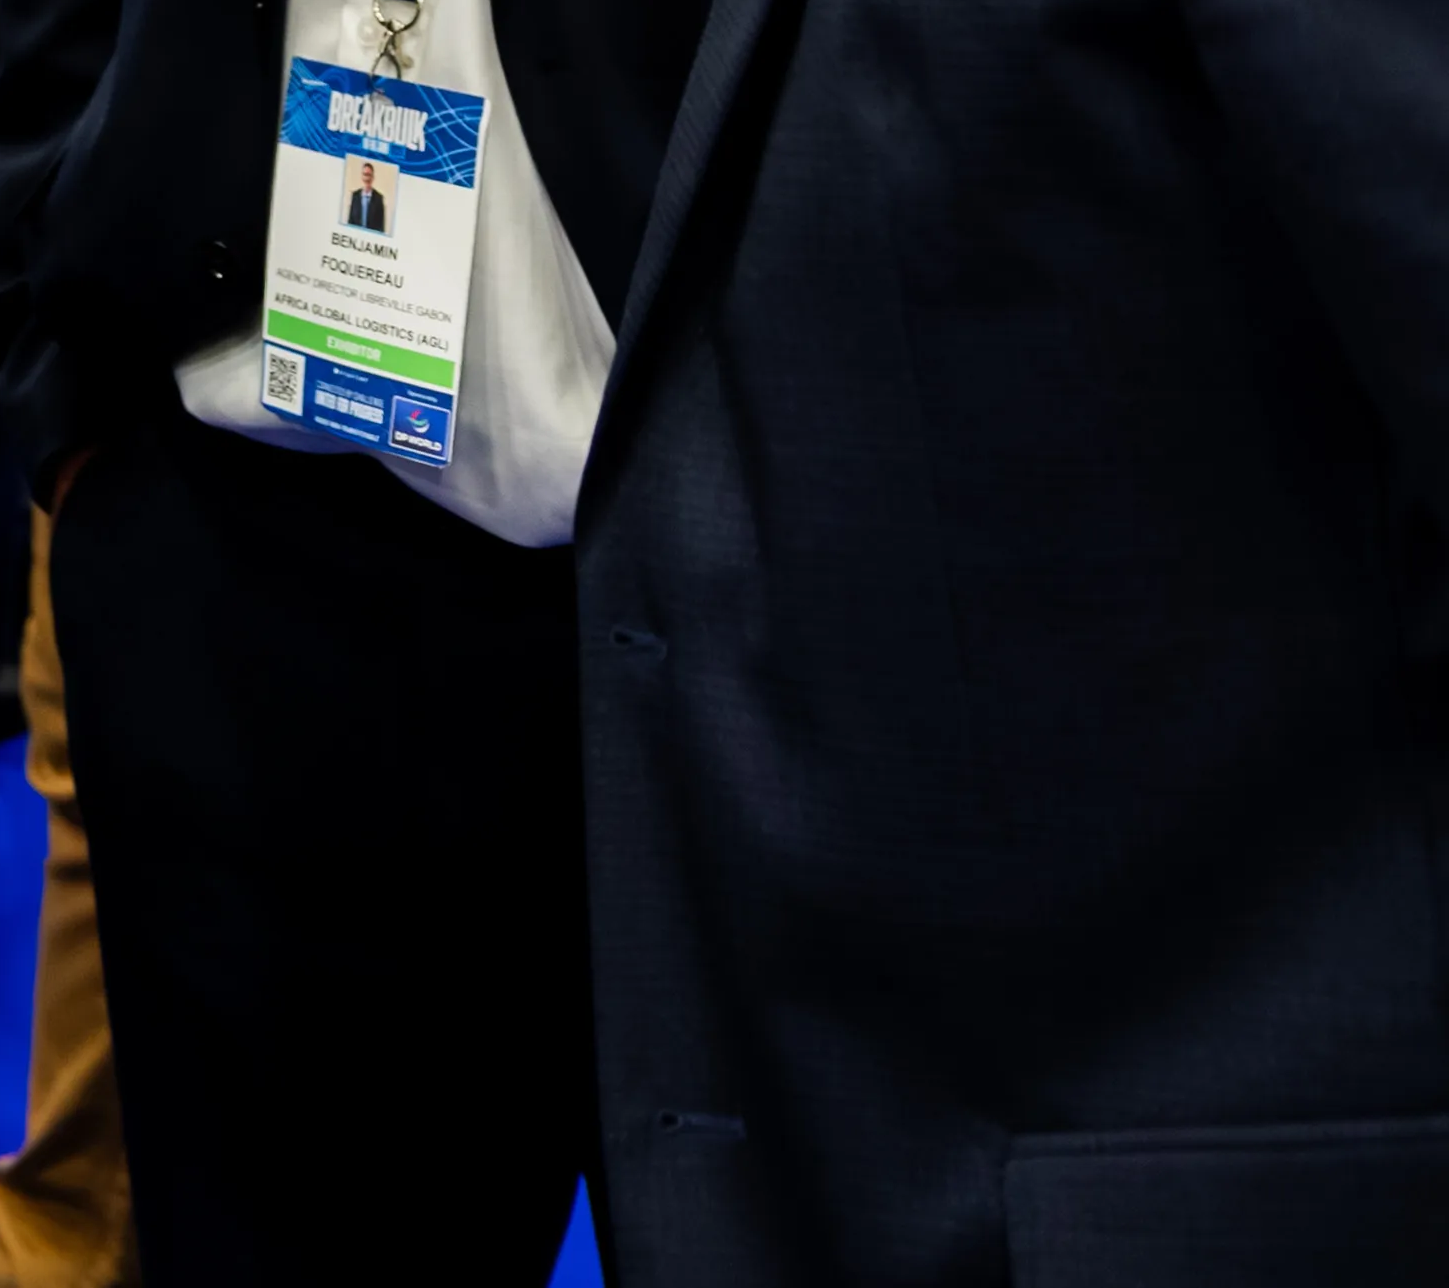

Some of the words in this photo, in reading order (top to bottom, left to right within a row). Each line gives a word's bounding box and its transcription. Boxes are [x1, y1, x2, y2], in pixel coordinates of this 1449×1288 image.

[326, 89, 429, 153] BREAKBULK
[330, 230, 399, 261] BENJAMIN
[320, 254, 405, 290] FOQUEREAU
[274, 291, 310, 312] AFRICA
[310, 302, 354, 326] GLOBAL
[354, 316, 415, 343] LOGISTICS
[416, 332, 450, 354] (AGL)
[311, 277, 359, 299] DIRECTOR
[358, 291, 414, 315] LIBREVILLE
[414, 305, 454, 324] GABON
